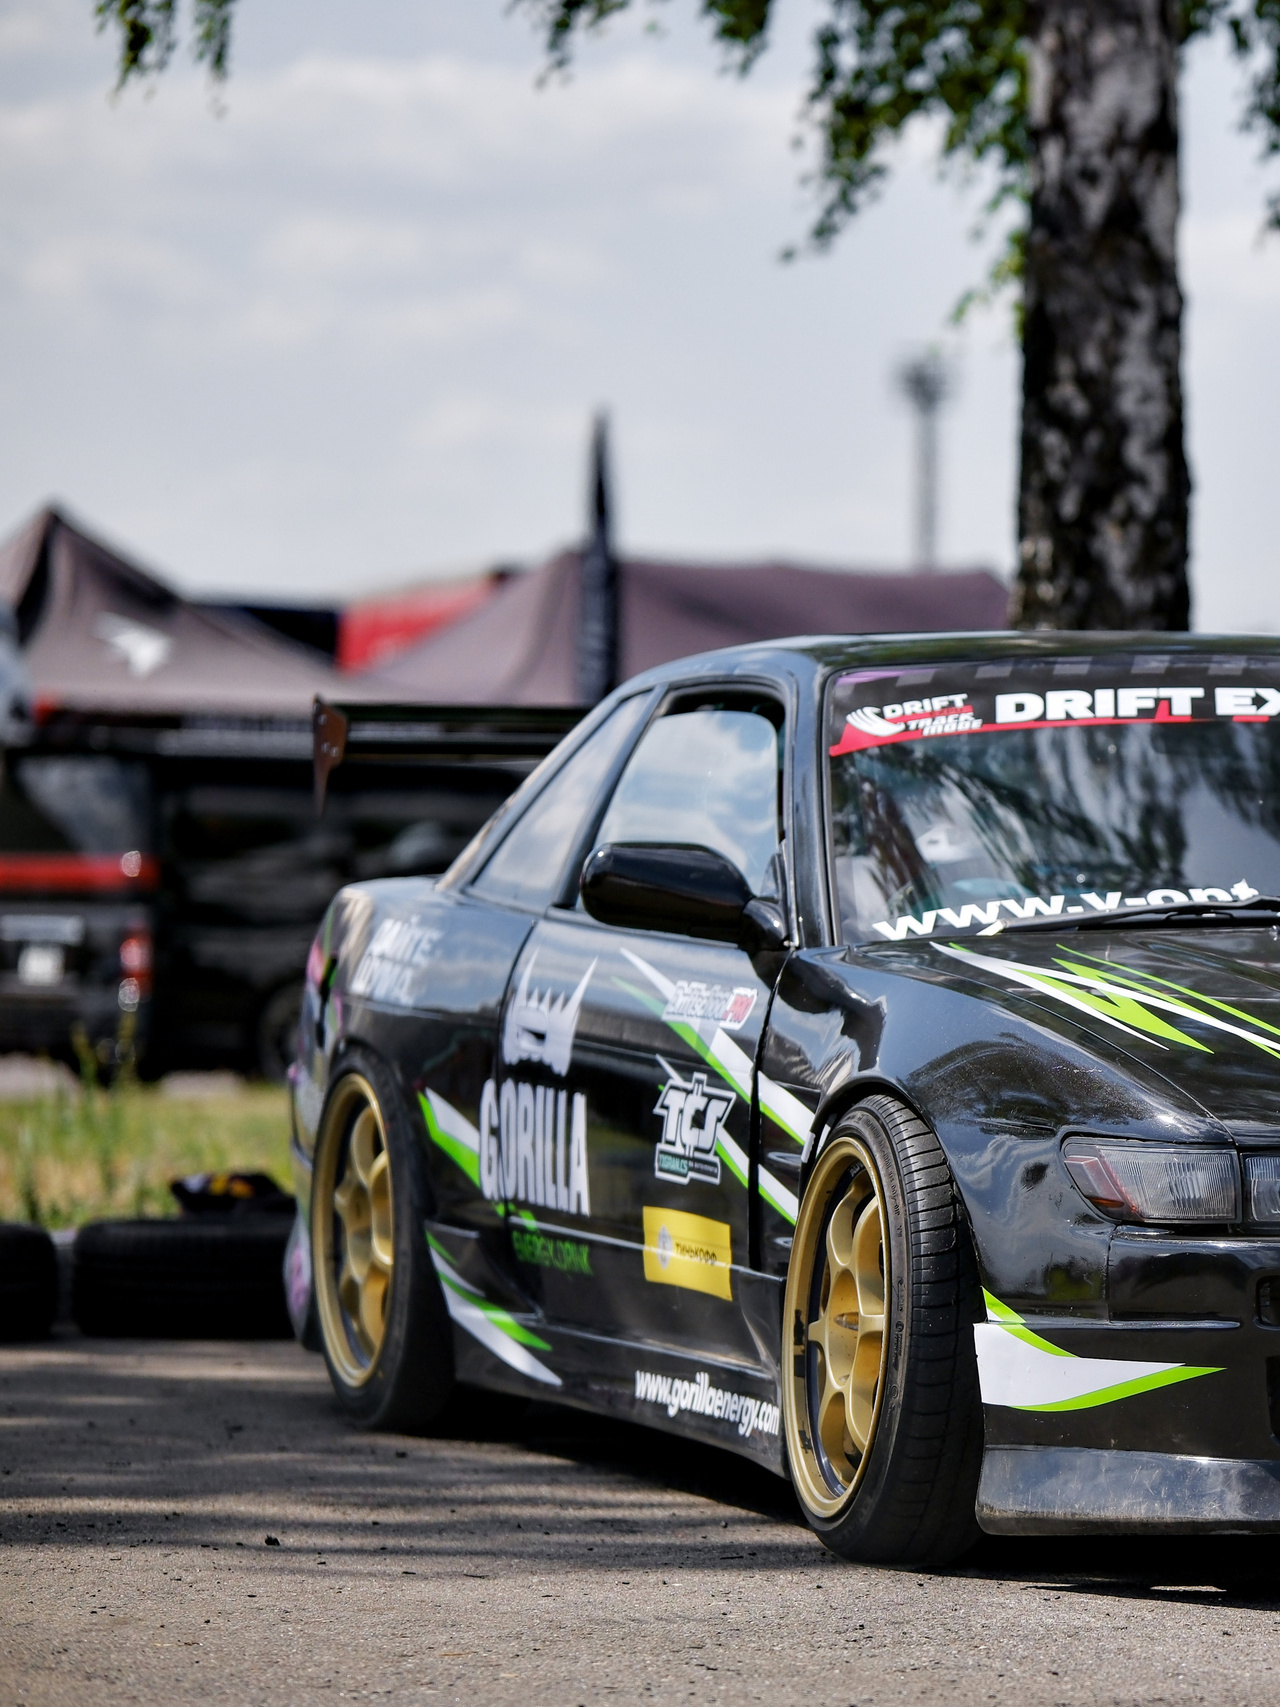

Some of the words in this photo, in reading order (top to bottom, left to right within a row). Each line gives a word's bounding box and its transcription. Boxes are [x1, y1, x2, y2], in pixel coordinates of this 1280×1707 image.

[882, 693, 968, 719] DRIFT
[995, 687, 1205, 724] DRIFT
[479, 1078, 591, 1217] GORILLA
[634, 1369, 780, 1437] www.gorillaenergy.com
